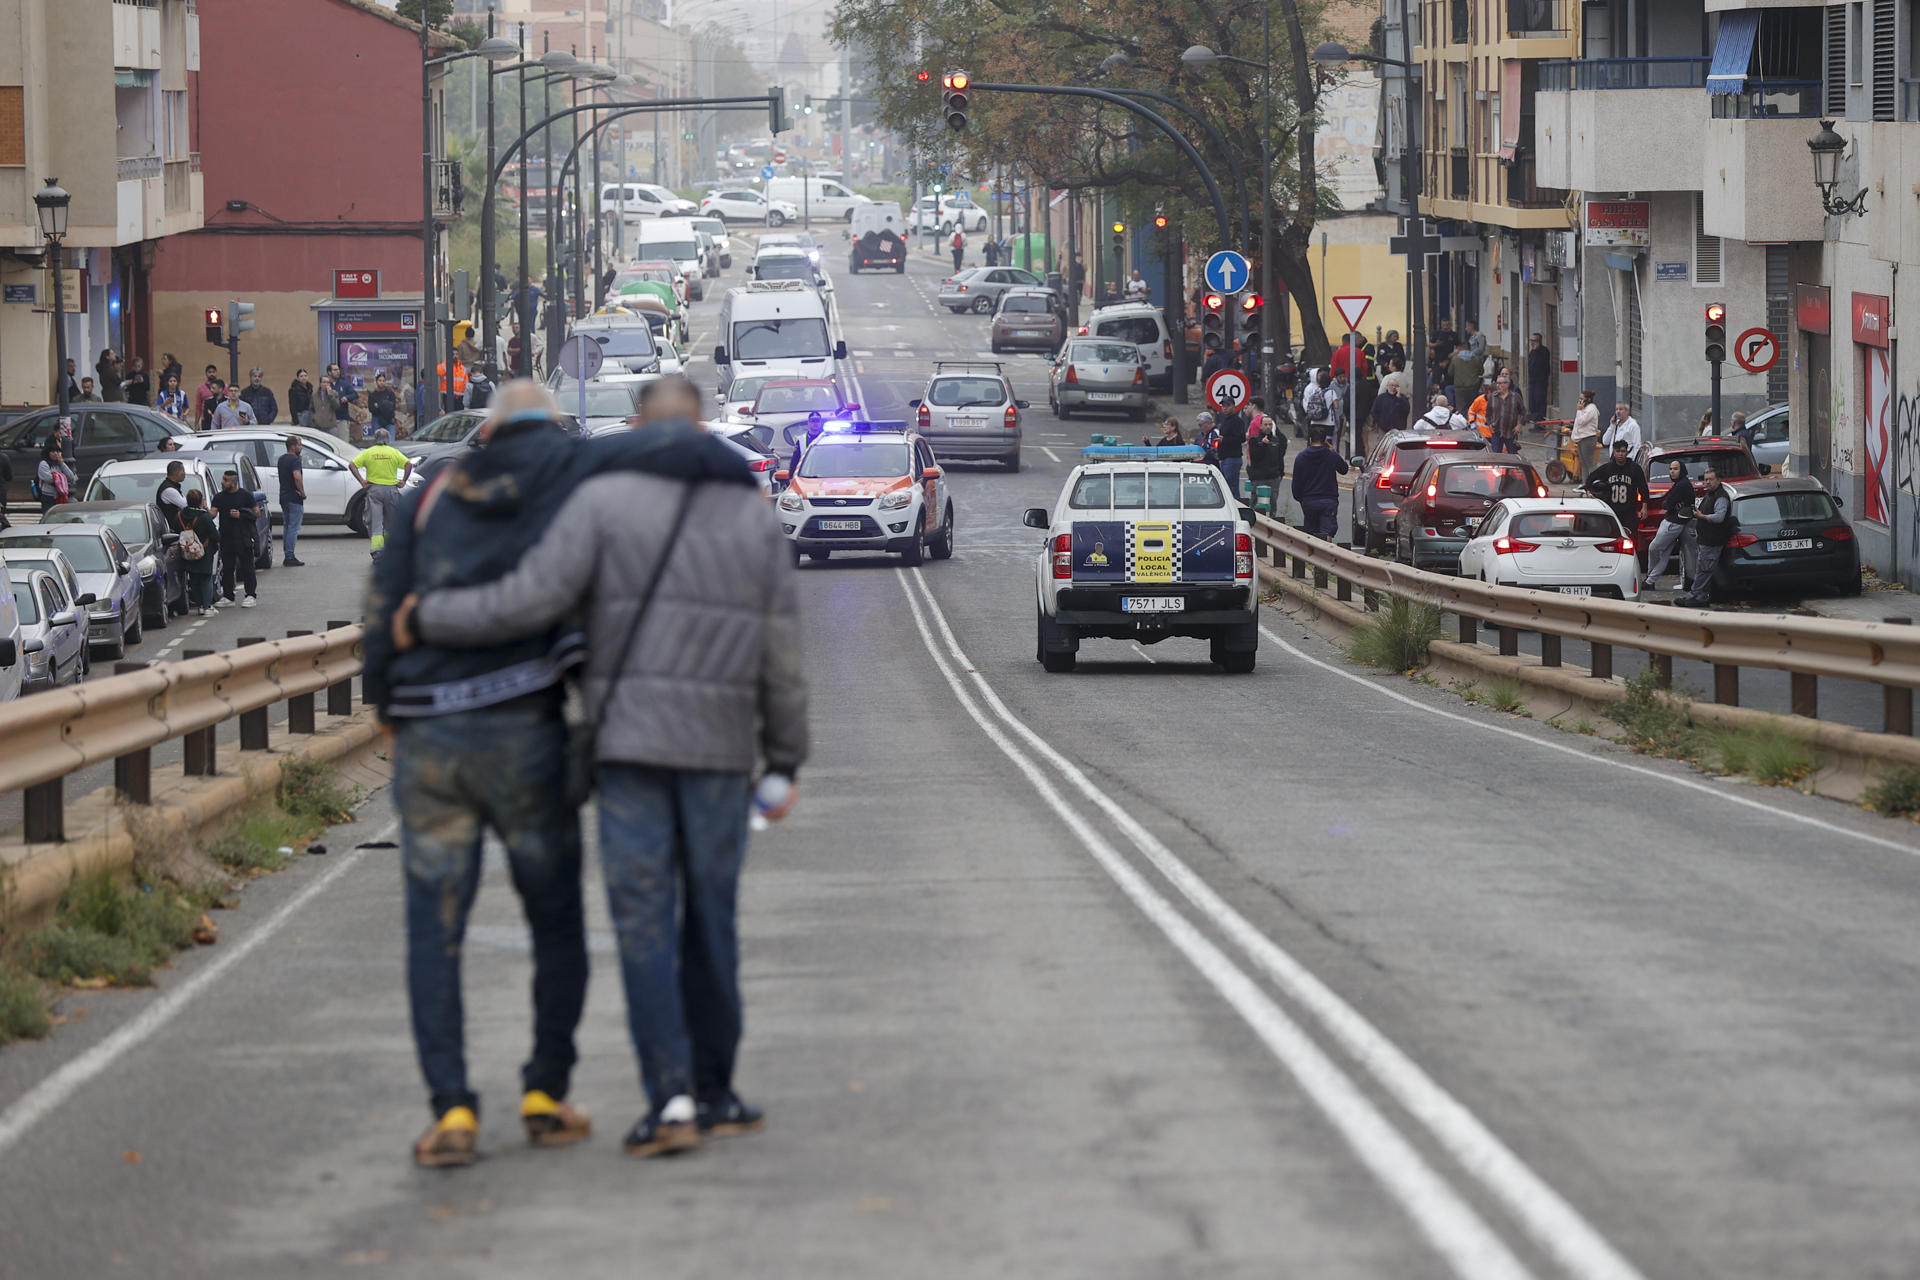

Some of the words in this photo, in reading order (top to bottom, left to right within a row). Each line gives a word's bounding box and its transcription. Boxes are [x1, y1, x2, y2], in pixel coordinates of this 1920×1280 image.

[1602, 205, 1637, 215] HIPER
[1590, 218, 1616, 227] CASA
[1215, 384, 1241, 399] 40
[1188, 476, 1213, 484] PLV
[1611, 484, 1627, 503] 08
[823, 521, 843, 529] 8644
[1772, 541, 1793, 550] 5836
[1794, 539, 1809, 548] JKT
[1573, 587, 1590, 595] HTV
[1129, 598, 1156, 609] 7571
[1161, 598, 1181, 609] JLS
